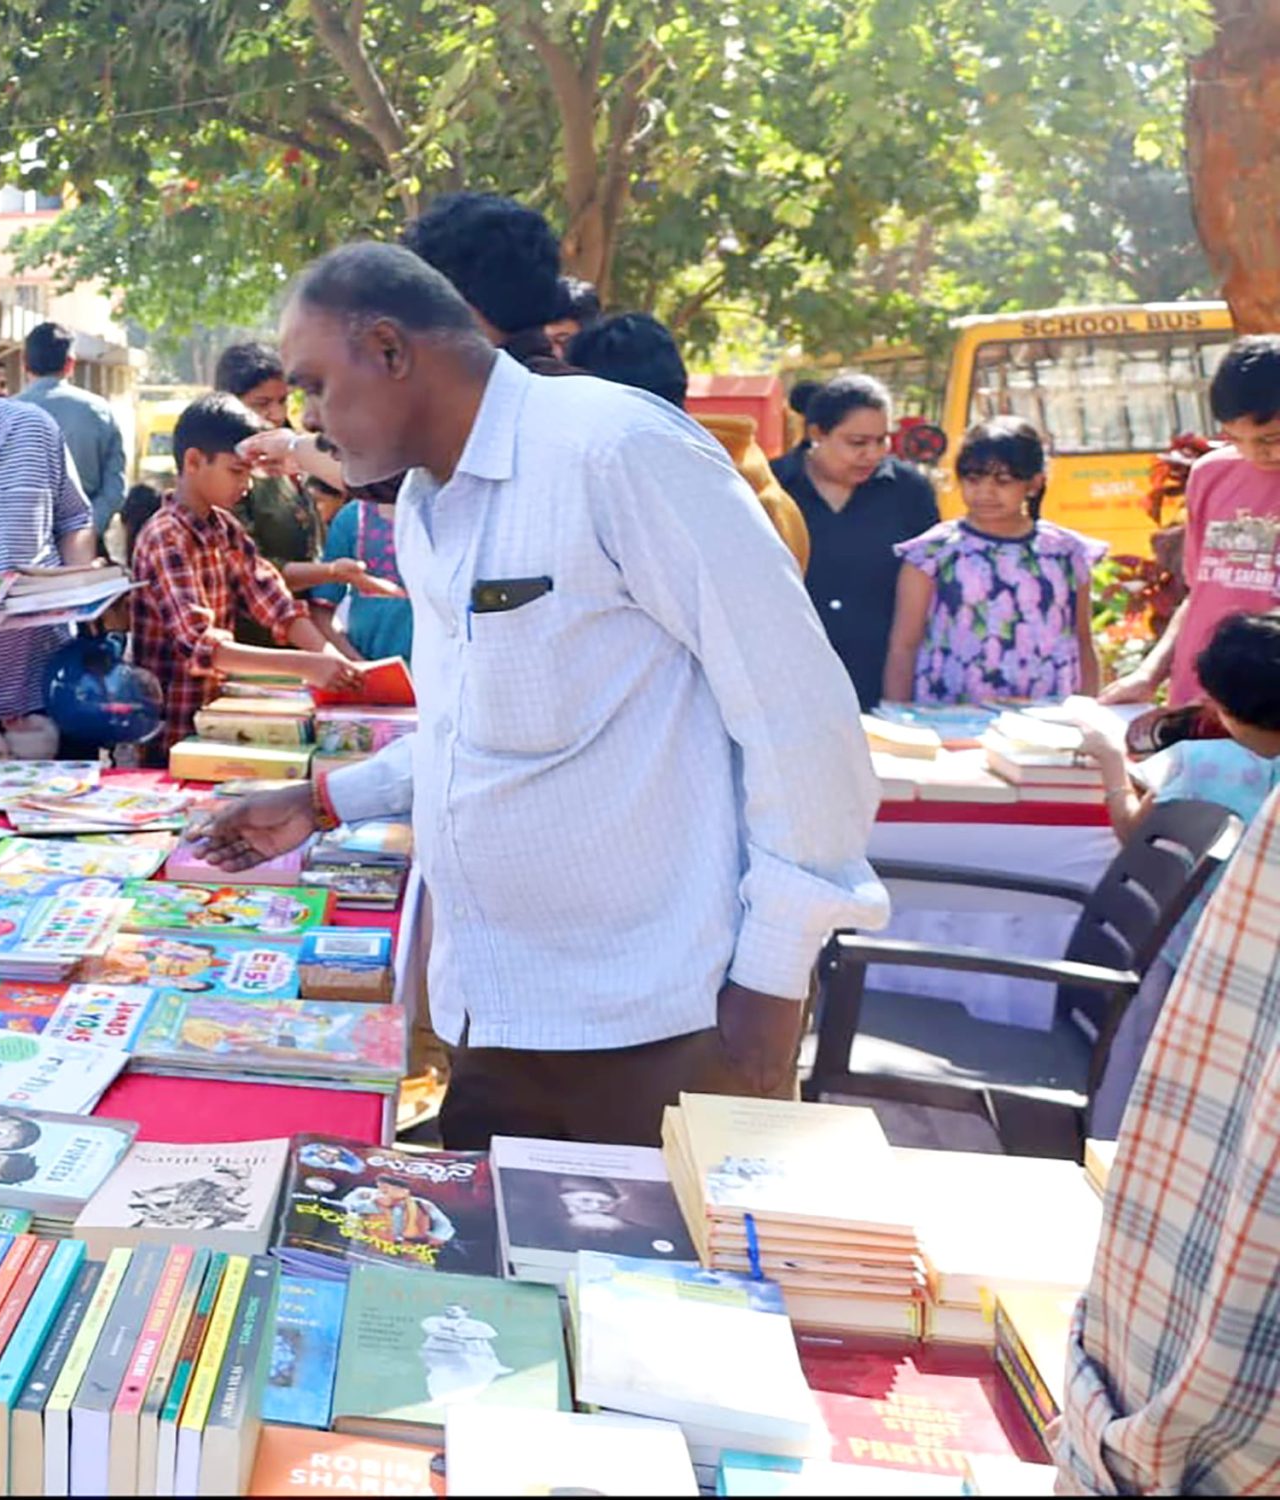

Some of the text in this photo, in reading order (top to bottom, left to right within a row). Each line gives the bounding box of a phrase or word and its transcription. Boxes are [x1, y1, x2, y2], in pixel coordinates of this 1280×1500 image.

[1021, 311, 1202, 336] SCHOOL BUS
[66, 991, 116, 1043] CRAYONS
[310, 1452, 423, 1483] ROBIN
[847, 1436, 967, 1471] PARTIT
